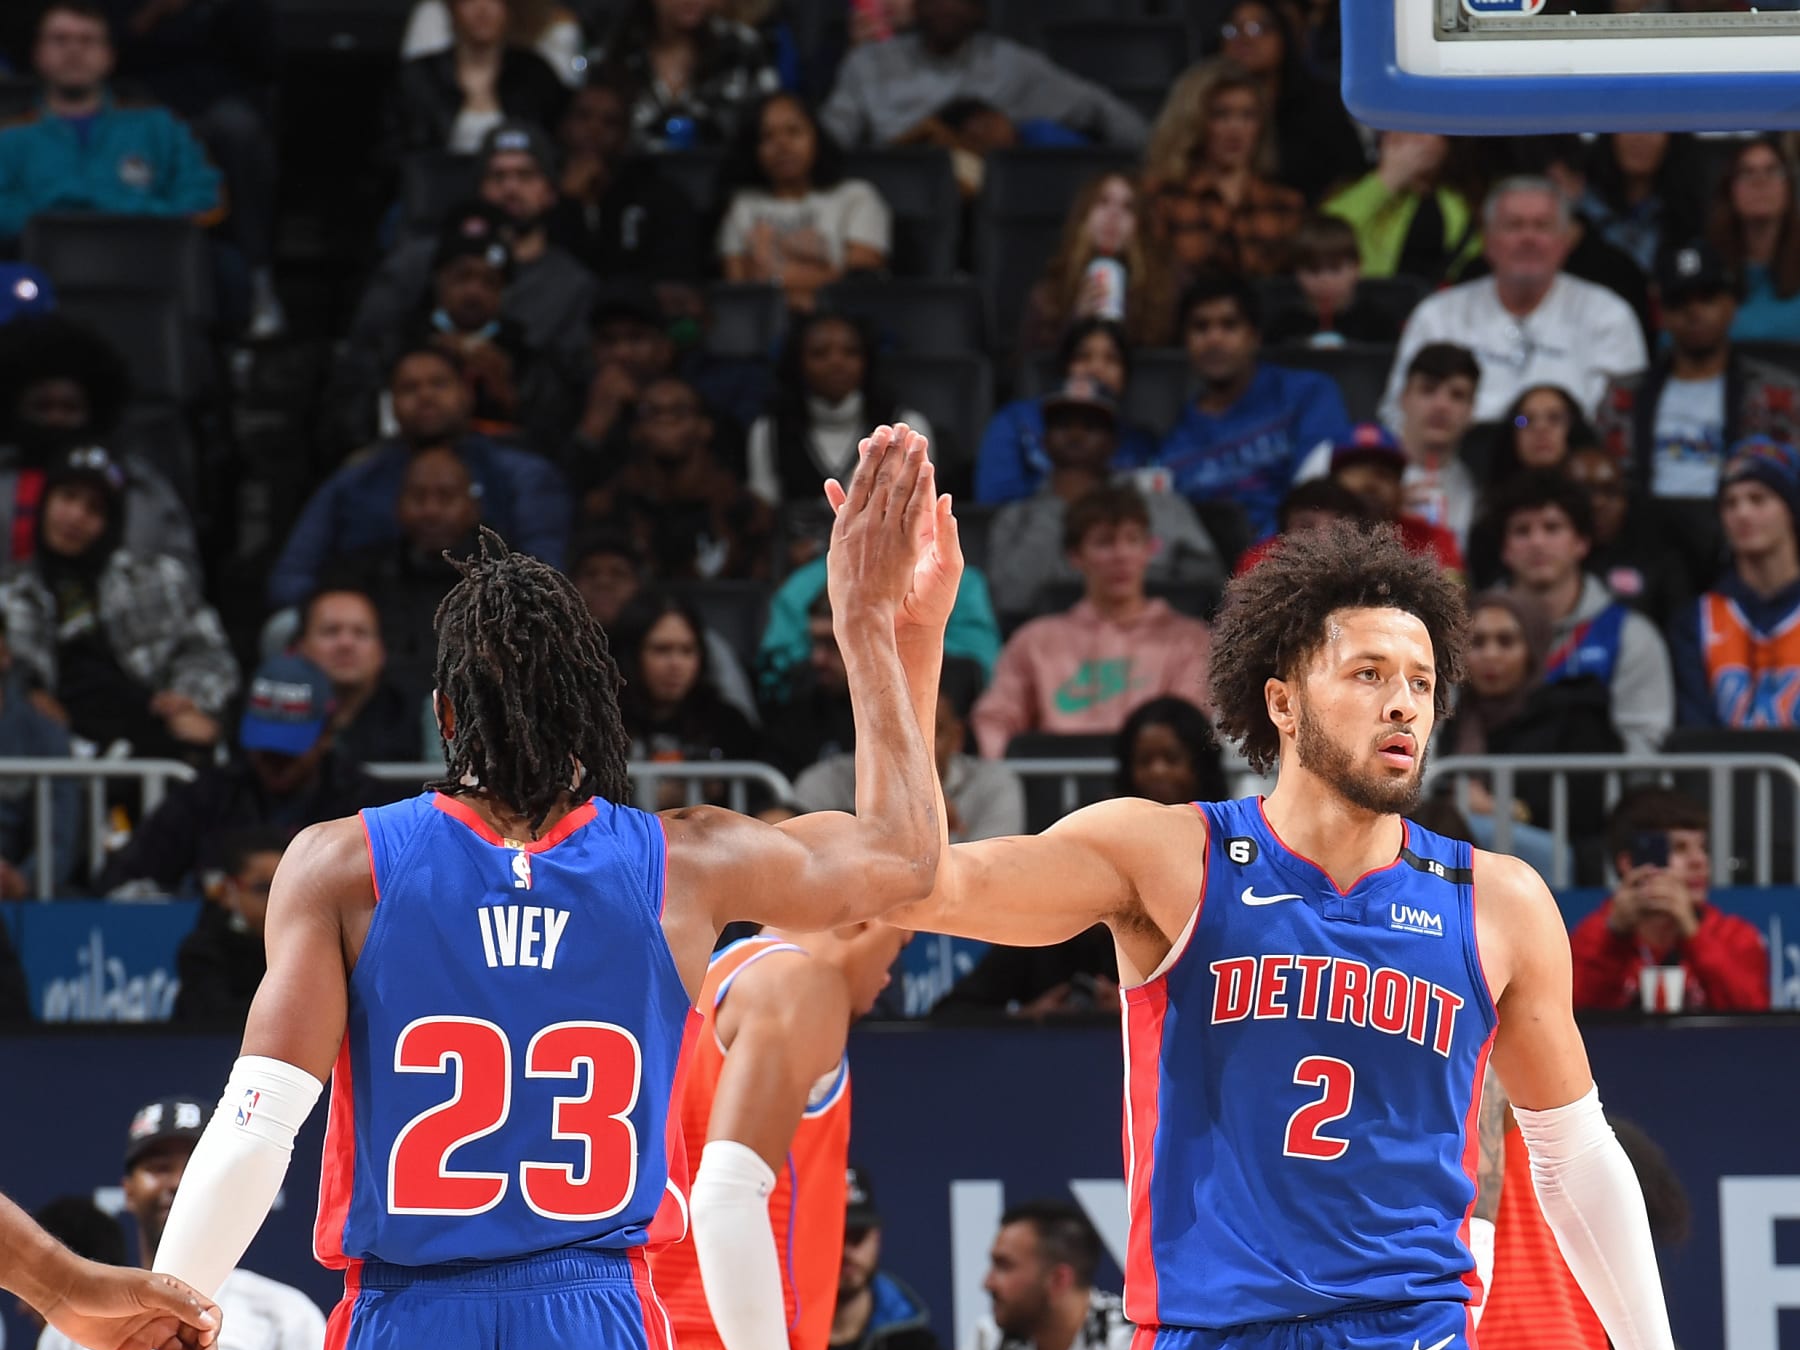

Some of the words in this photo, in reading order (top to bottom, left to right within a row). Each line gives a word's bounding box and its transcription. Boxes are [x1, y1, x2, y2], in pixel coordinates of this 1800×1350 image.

[1230, 841, 1250, 863] 6
[478, 905, 570, 969] IVEY
[1391, 903, 1443, 930] UWM
[1209, 955, 1464, 1058] DETROIT
[388, 1015, 642, 1222] 23
[1283, 1055, 1355, 1161] 2
